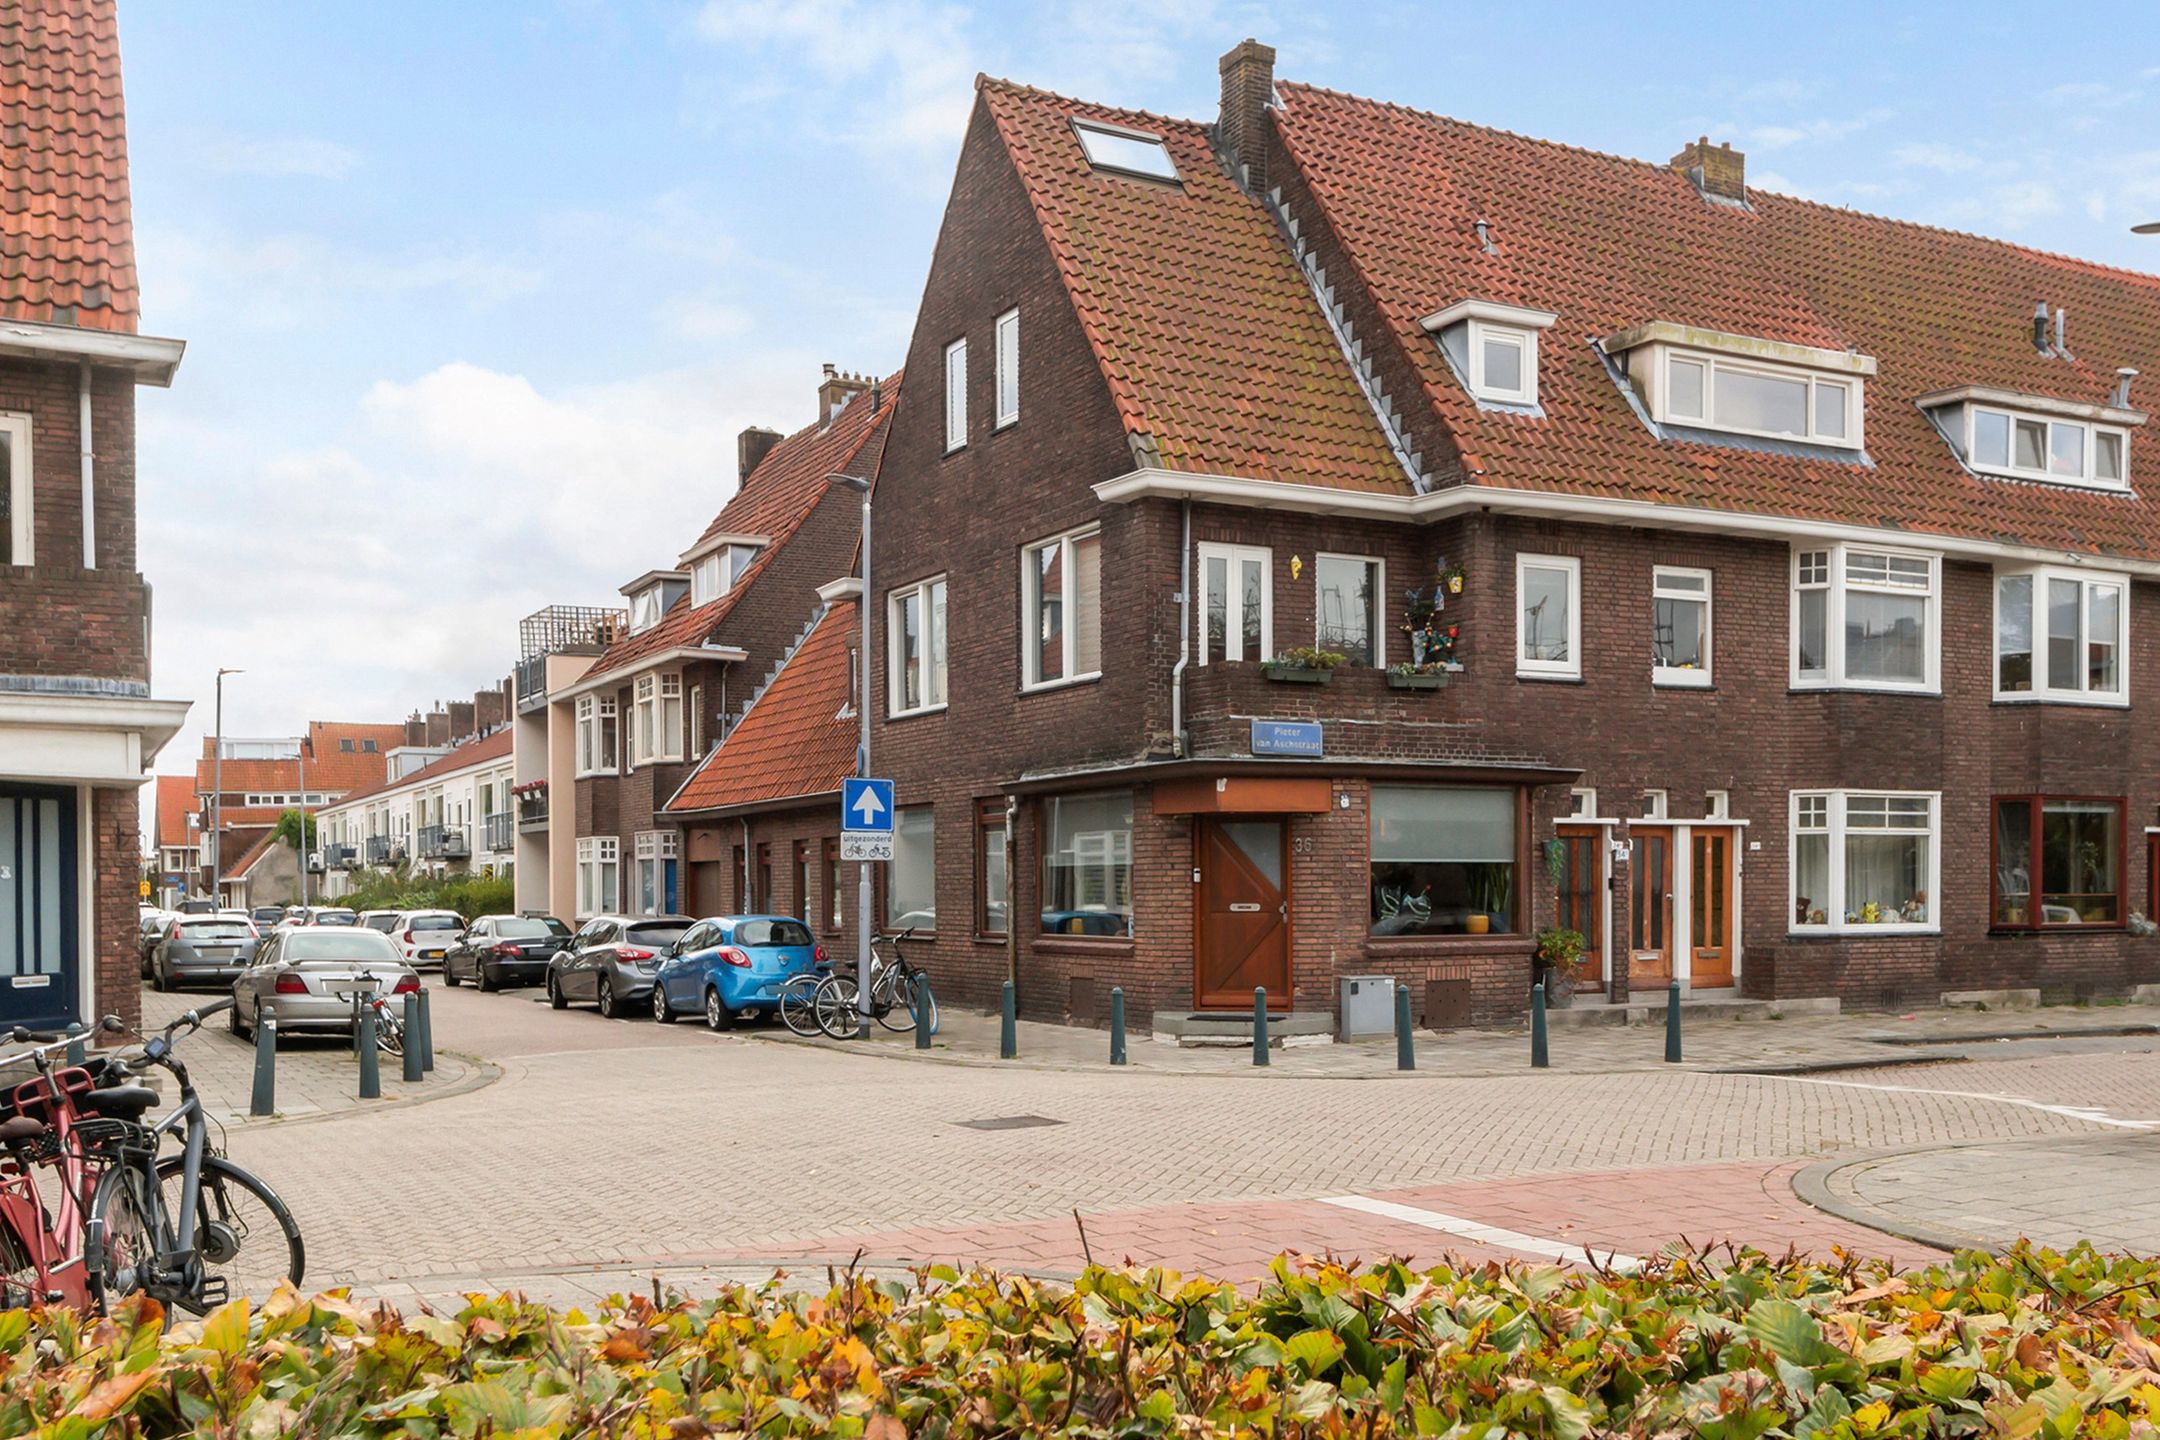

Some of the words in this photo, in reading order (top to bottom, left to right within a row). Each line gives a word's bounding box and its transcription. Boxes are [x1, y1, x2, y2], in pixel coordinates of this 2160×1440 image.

[1274, 727, 1301, 737] Pieter
[843, 834, 892, 844] uitgezonderd
[1295, 837, 1313, 853] 36
